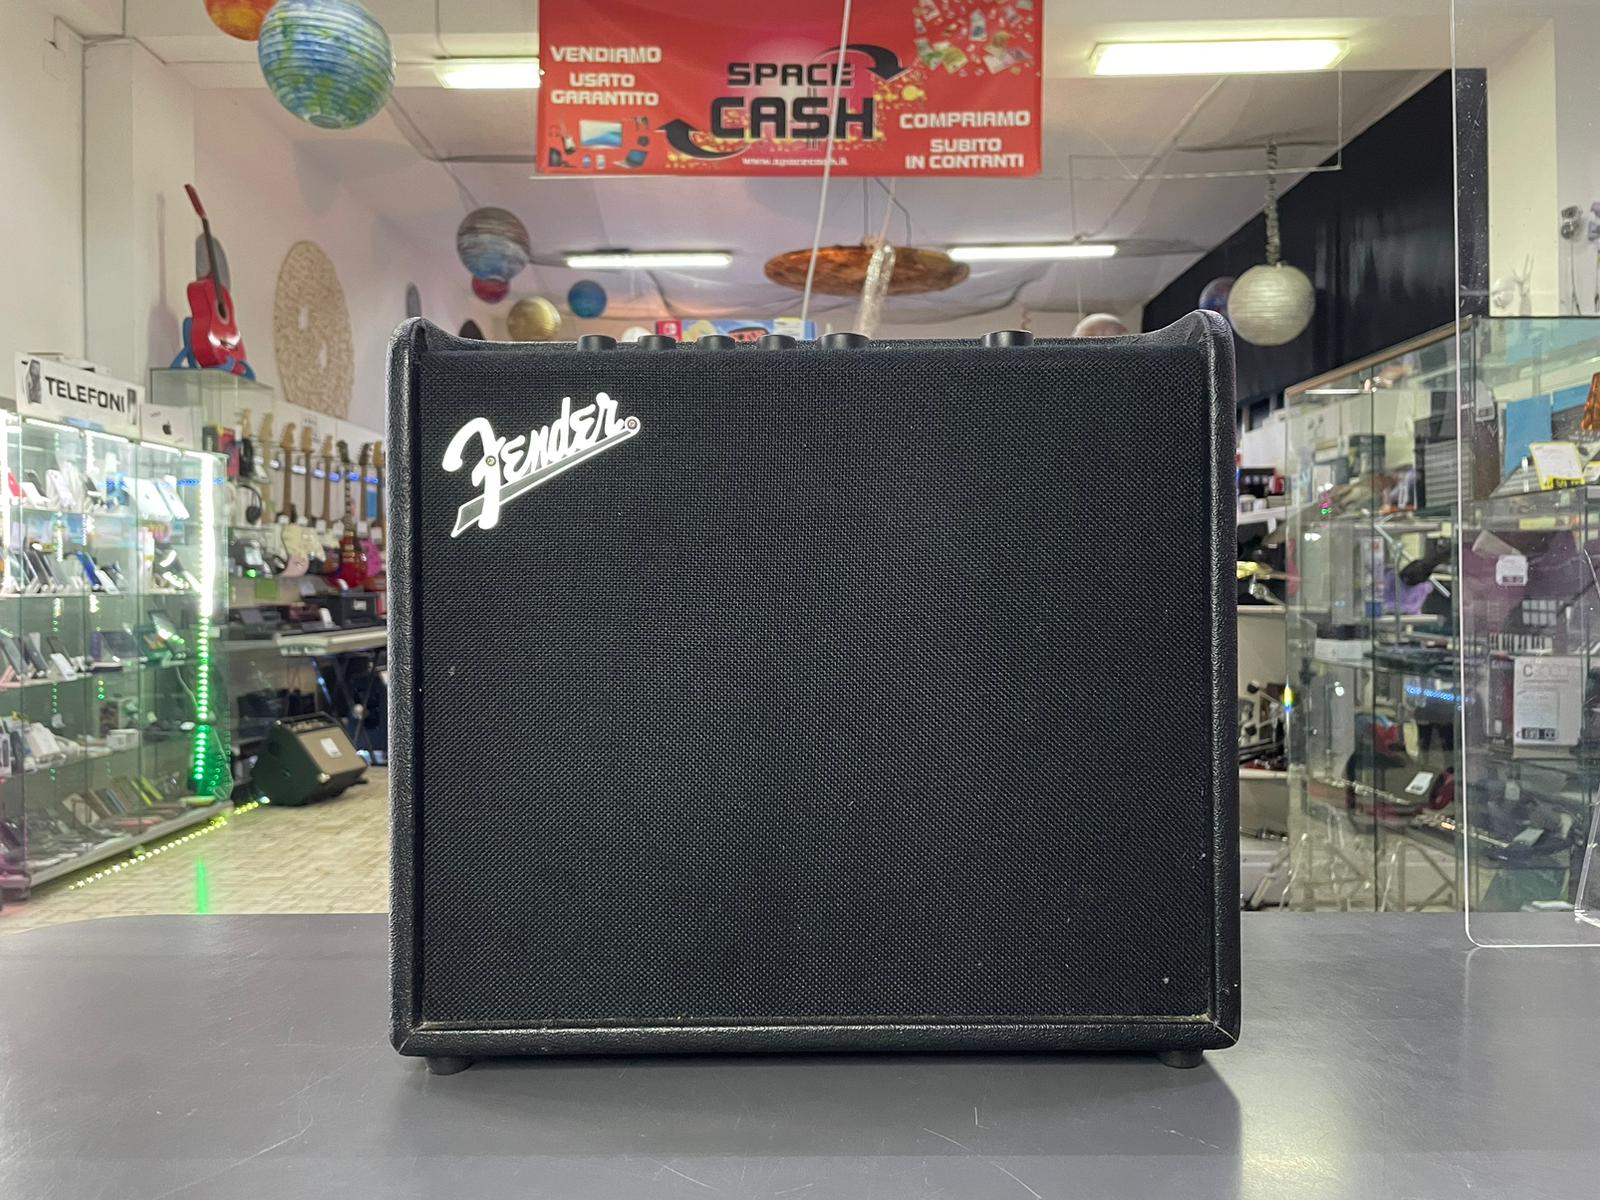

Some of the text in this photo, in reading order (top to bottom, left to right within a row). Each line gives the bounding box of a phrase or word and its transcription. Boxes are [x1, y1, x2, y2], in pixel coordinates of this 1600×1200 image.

[550, 46, 662, 63] VENDIAMO
[569, 72, 635, 88] USATO
[728, 63, 852, 87] SPACE
[550, 89, 659, 106] GARANTITO
[711, 97, 875, 139] CASH
[899, 110, 1031, 129] COMPRIAMO
[929, 137, 1002, 153] SUBITO
[904, 153, 1024, 169] IN CONTANTI
[45, 376, 125, 413] TELEFONI
[442, 392, 641, 538] Fender
